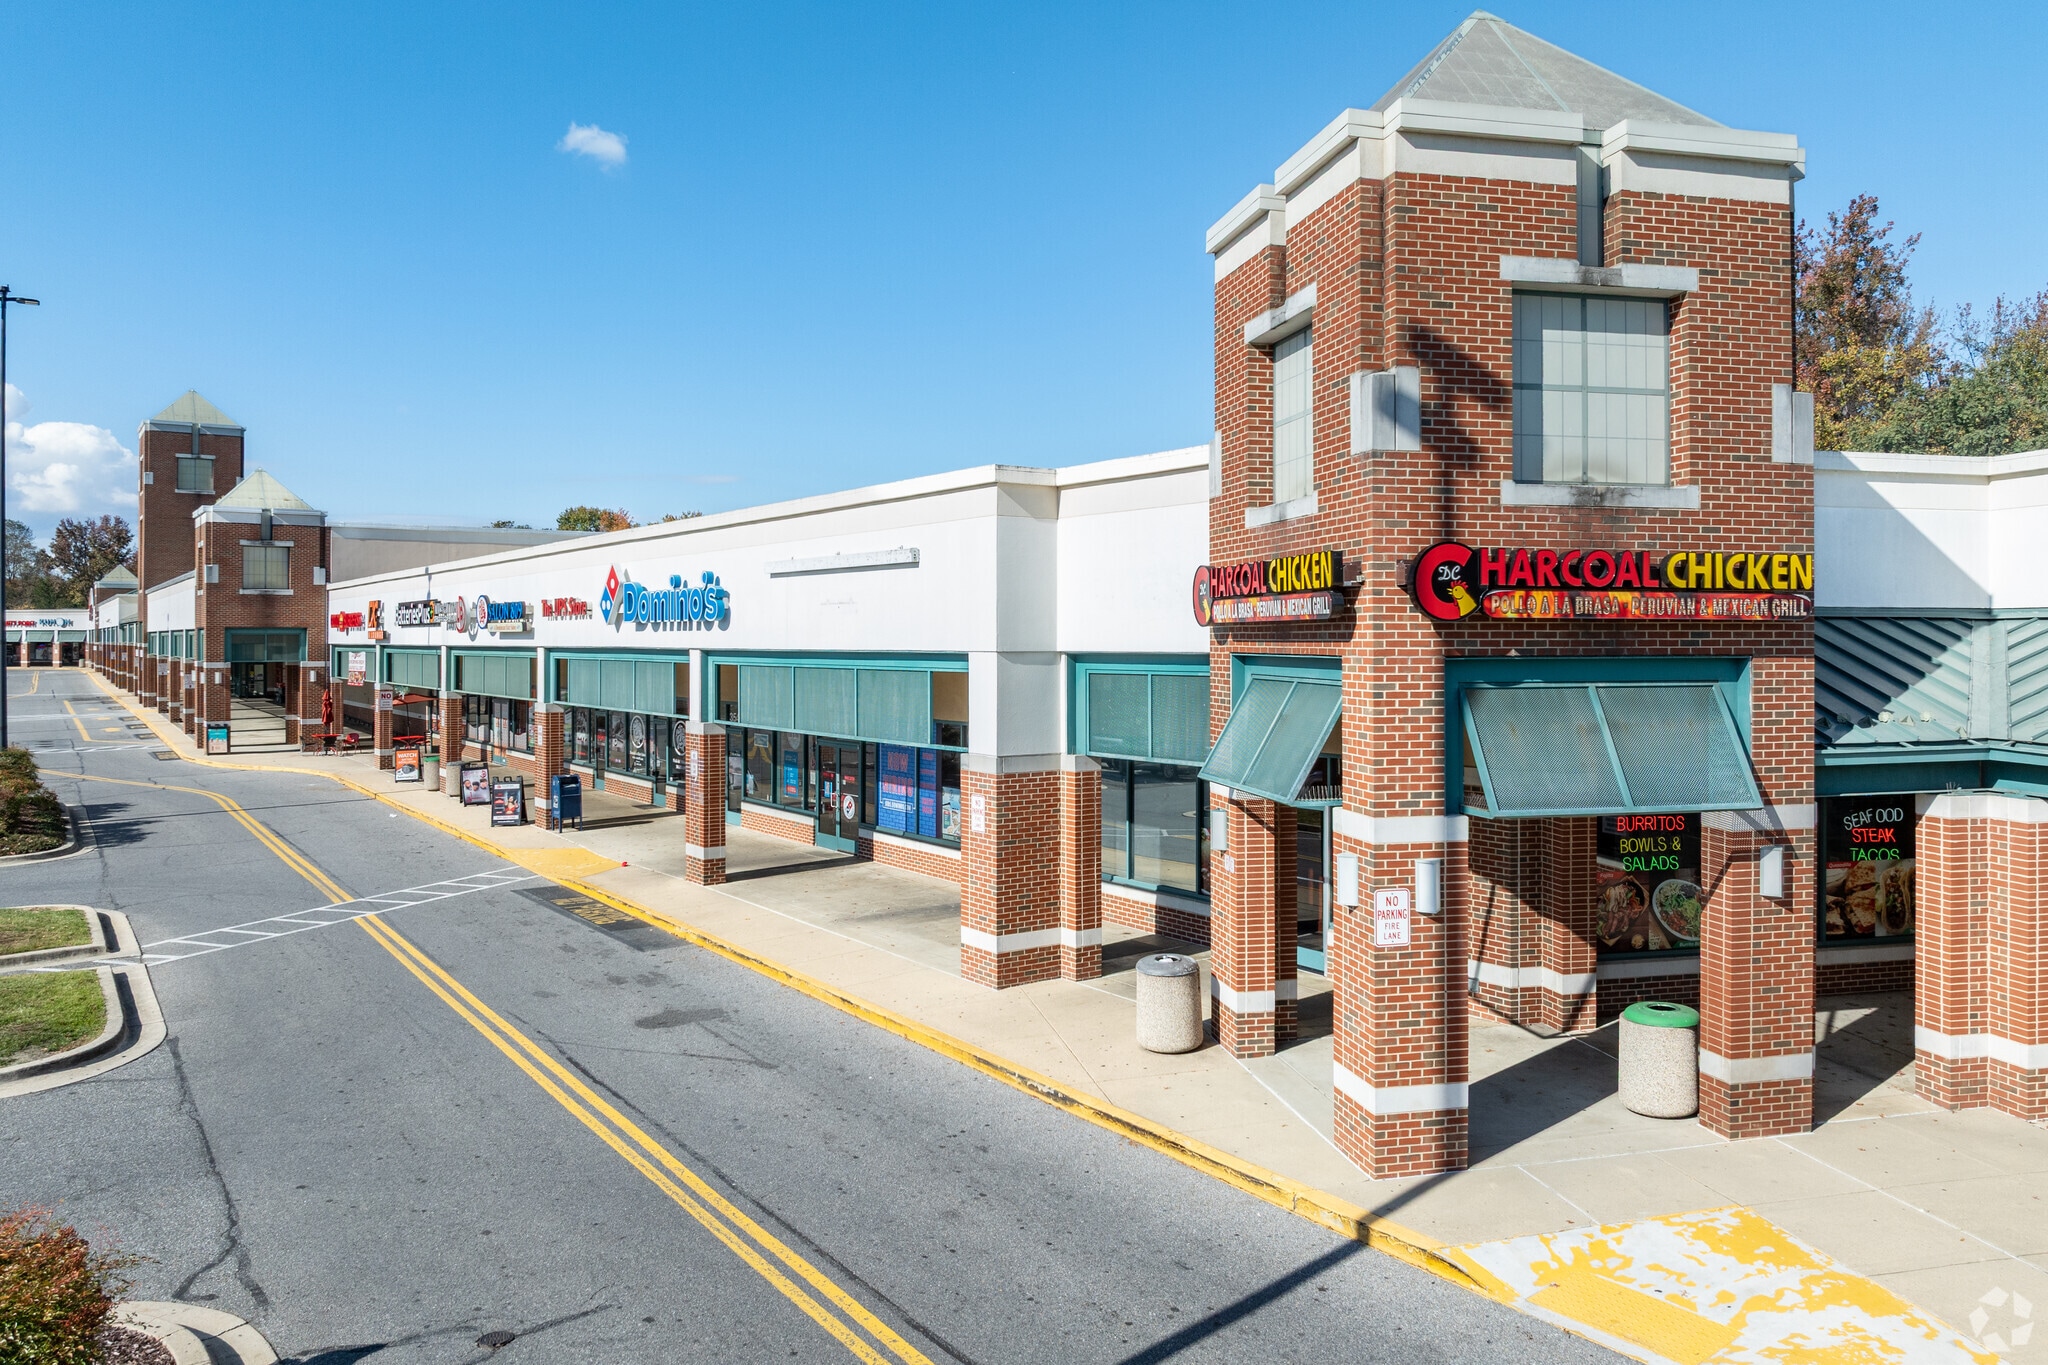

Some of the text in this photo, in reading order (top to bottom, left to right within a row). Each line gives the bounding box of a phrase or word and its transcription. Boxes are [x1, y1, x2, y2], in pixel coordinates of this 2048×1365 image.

[1268, 550, 1332, 592] CHICKEN
[1437, 565, 1462, 581] DC
[1666, 552, 1813, 590] CHICKEN
[623, 570, 720, 624] Domino's
[488, 603, 509, 621] SALON
[541, 599, 553, 617] The
[568, 597, 588, 616] Store
[1257, 599, 1281, 618] PERUVIAN
[1287, 597, 1313, 616] MEXICAN
[1312, 596, 1330, 615] GRILL
[1491, 595, 1808, 617] POLLO A LA BRASA PERUVIAN & MEXICAN GRILL
[888, 752, 909, 772] NOW
[1616, 815, 1685, 832] BURRITOS
[1852, 828, 1897, 843] STEAK
[1620, 836, 1682, 854] BOWLS &
[1849, 847, 1900, 862] TACOS
[1622, 855, 1680, 872] SALADS
[1385, 895, 1399, 907] NO
[1377, 908, 1408, 920] PARKING
[1384, 922, 1400, 930] FIRE
[1383, 931, 1401, 940] LANE
